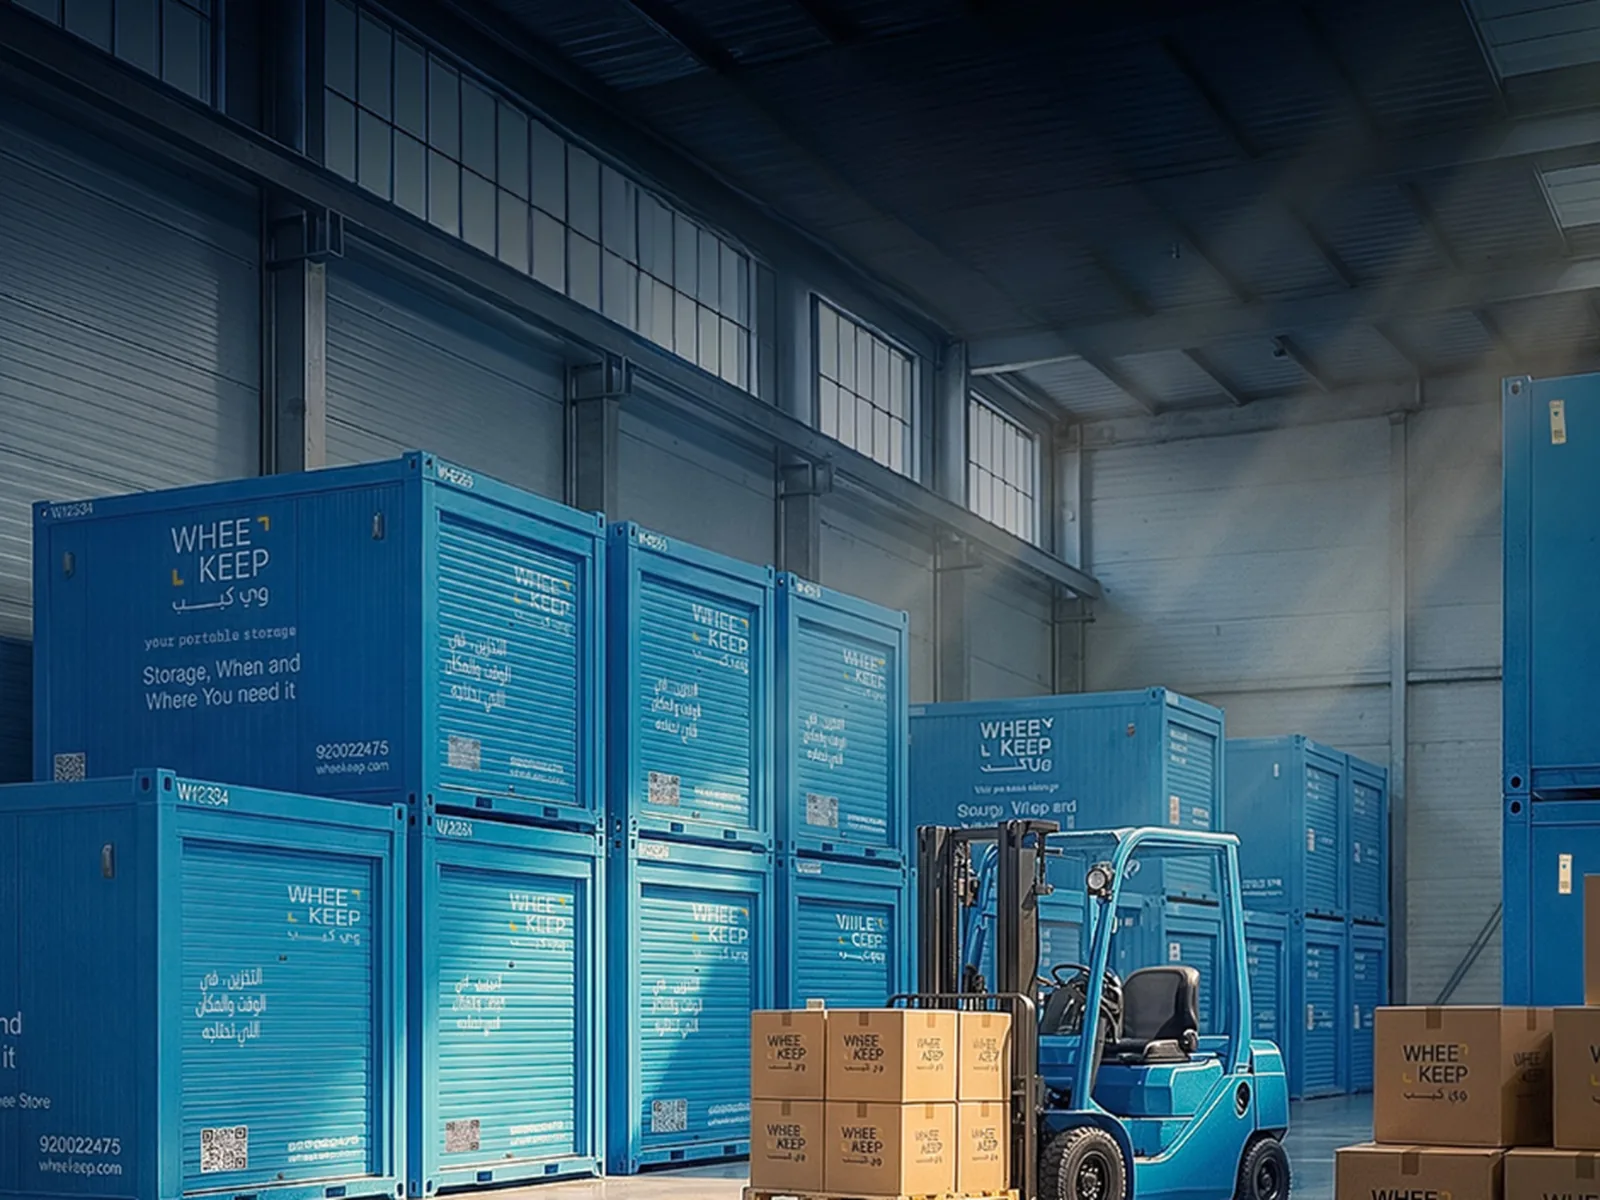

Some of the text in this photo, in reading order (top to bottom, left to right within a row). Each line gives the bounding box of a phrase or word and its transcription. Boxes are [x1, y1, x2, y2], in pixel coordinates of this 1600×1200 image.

[171, 518, 251, 554] WHEE
[200, 548, 269, 583] KEEP
[144, 626, 296, 651] your portable storage
[708, 628, 749, 655] KEEP
[143, 653, 300, 686] Storage, When and
[145, 680, 296, 711] Where You need it
[315, 740, 389, 760] 920022475
[1000, 737, 1052, 757] KEEP
[287, 885, 348, 907] WHEE
[510, 892, 557, 914] WHEE
[308, 906, 360, 927] KEEP
[692, 903, 739, 925] WHEE
[708, 925, 749, 945] KEEP
[767, 1034, 802, 1047] WHEE
[843, 1034, 880, 1047] WHEE
[3, 1044, 16, 1069] it
[777, 1047, 807, 1060] KEEP
[853, 1047, 885, 1061] KEEP
[1403, 1044, 1459, 1062] WHEE
[1419, 1065, 1468, 1083] KEEP
[19, 1092, 51, 1110] Store
[767, 1123, 801, 1137] WHEE
[841, 1126, 877, 1140] WHEE
[39, 1135, 122, 1155] 920022475
[776, 1137, 806, 1150] KEEP
